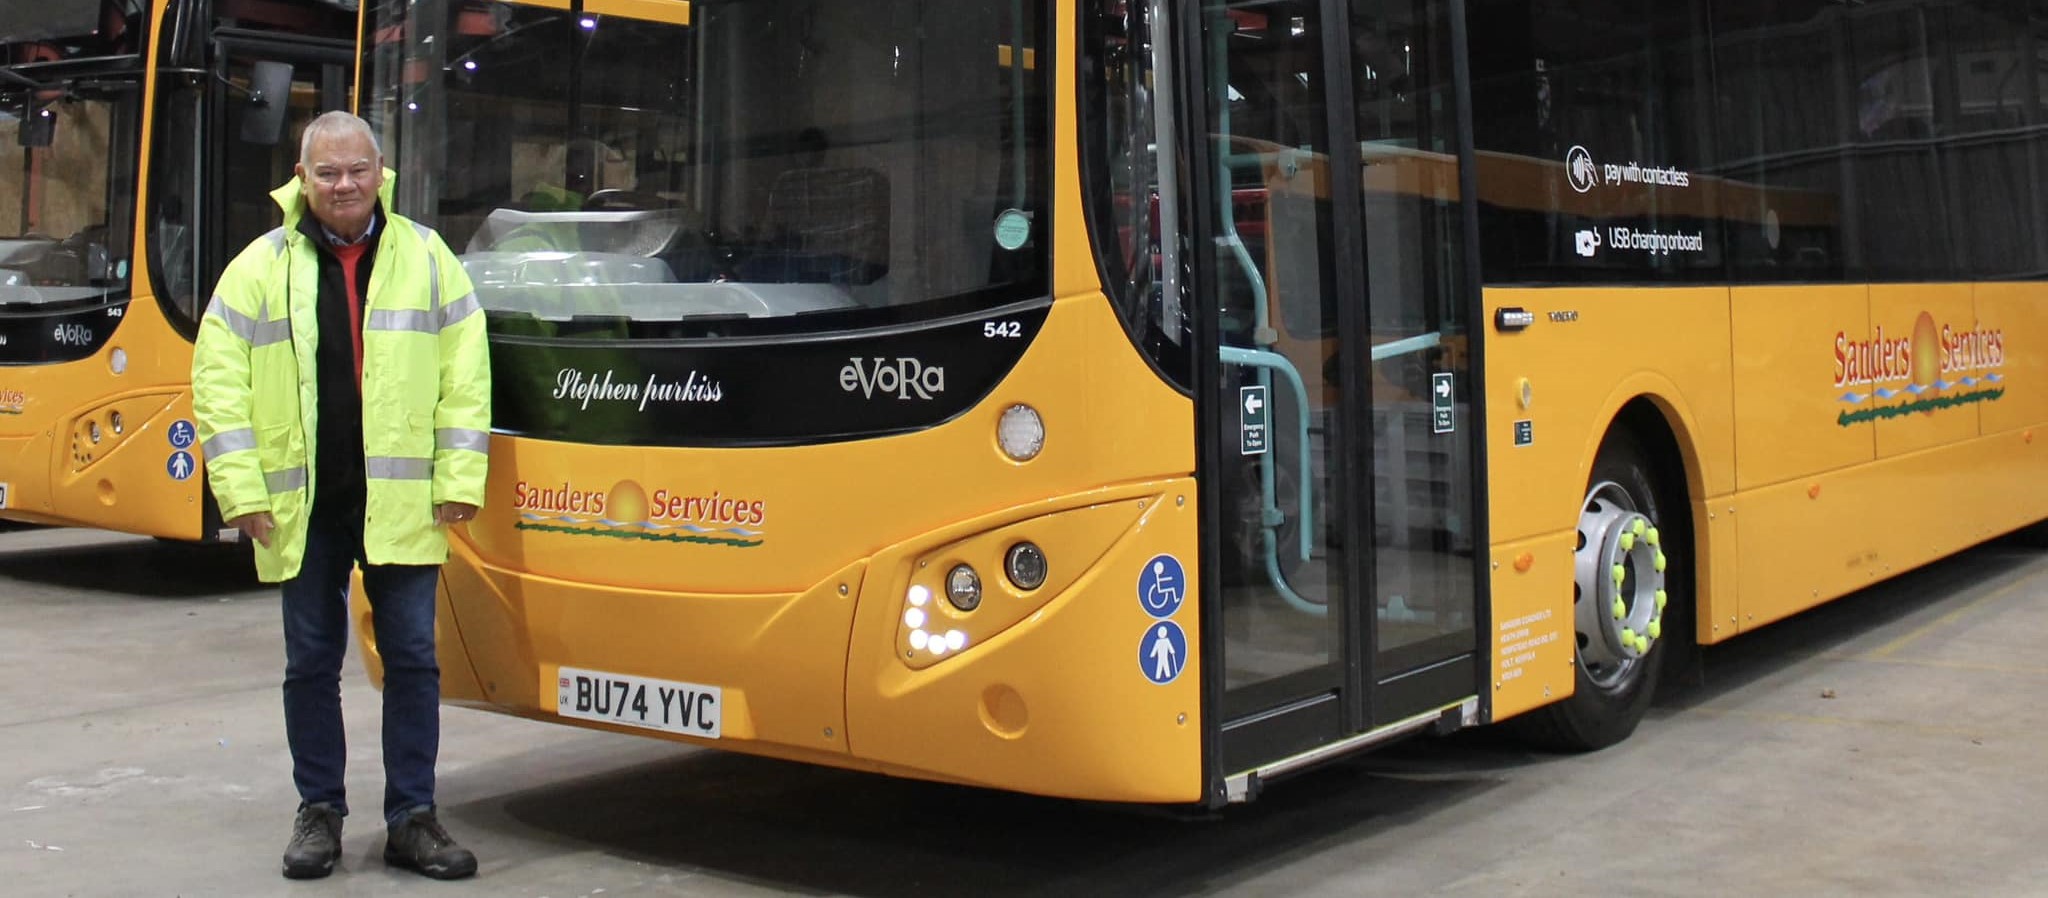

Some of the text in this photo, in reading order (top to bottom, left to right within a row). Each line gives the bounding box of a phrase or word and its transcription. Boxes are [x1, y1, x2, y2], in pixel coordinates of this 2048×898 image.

[1604, 161, 1689, 187] pay with contactless
[1608, 226, 1703, 255] USB charging onboard
[107, 307, 122, 317] 543
[983, 321, 1021, 338] 542
[1834, 321, 2005, 388] Sanders Services
[553, 367, 723, 412] Stephen purkiss
[514, 481, 765, 526] Sanders Services
[560, 696, 568, 705] UK
[576, 676, 714, 730] BU74 YVC
